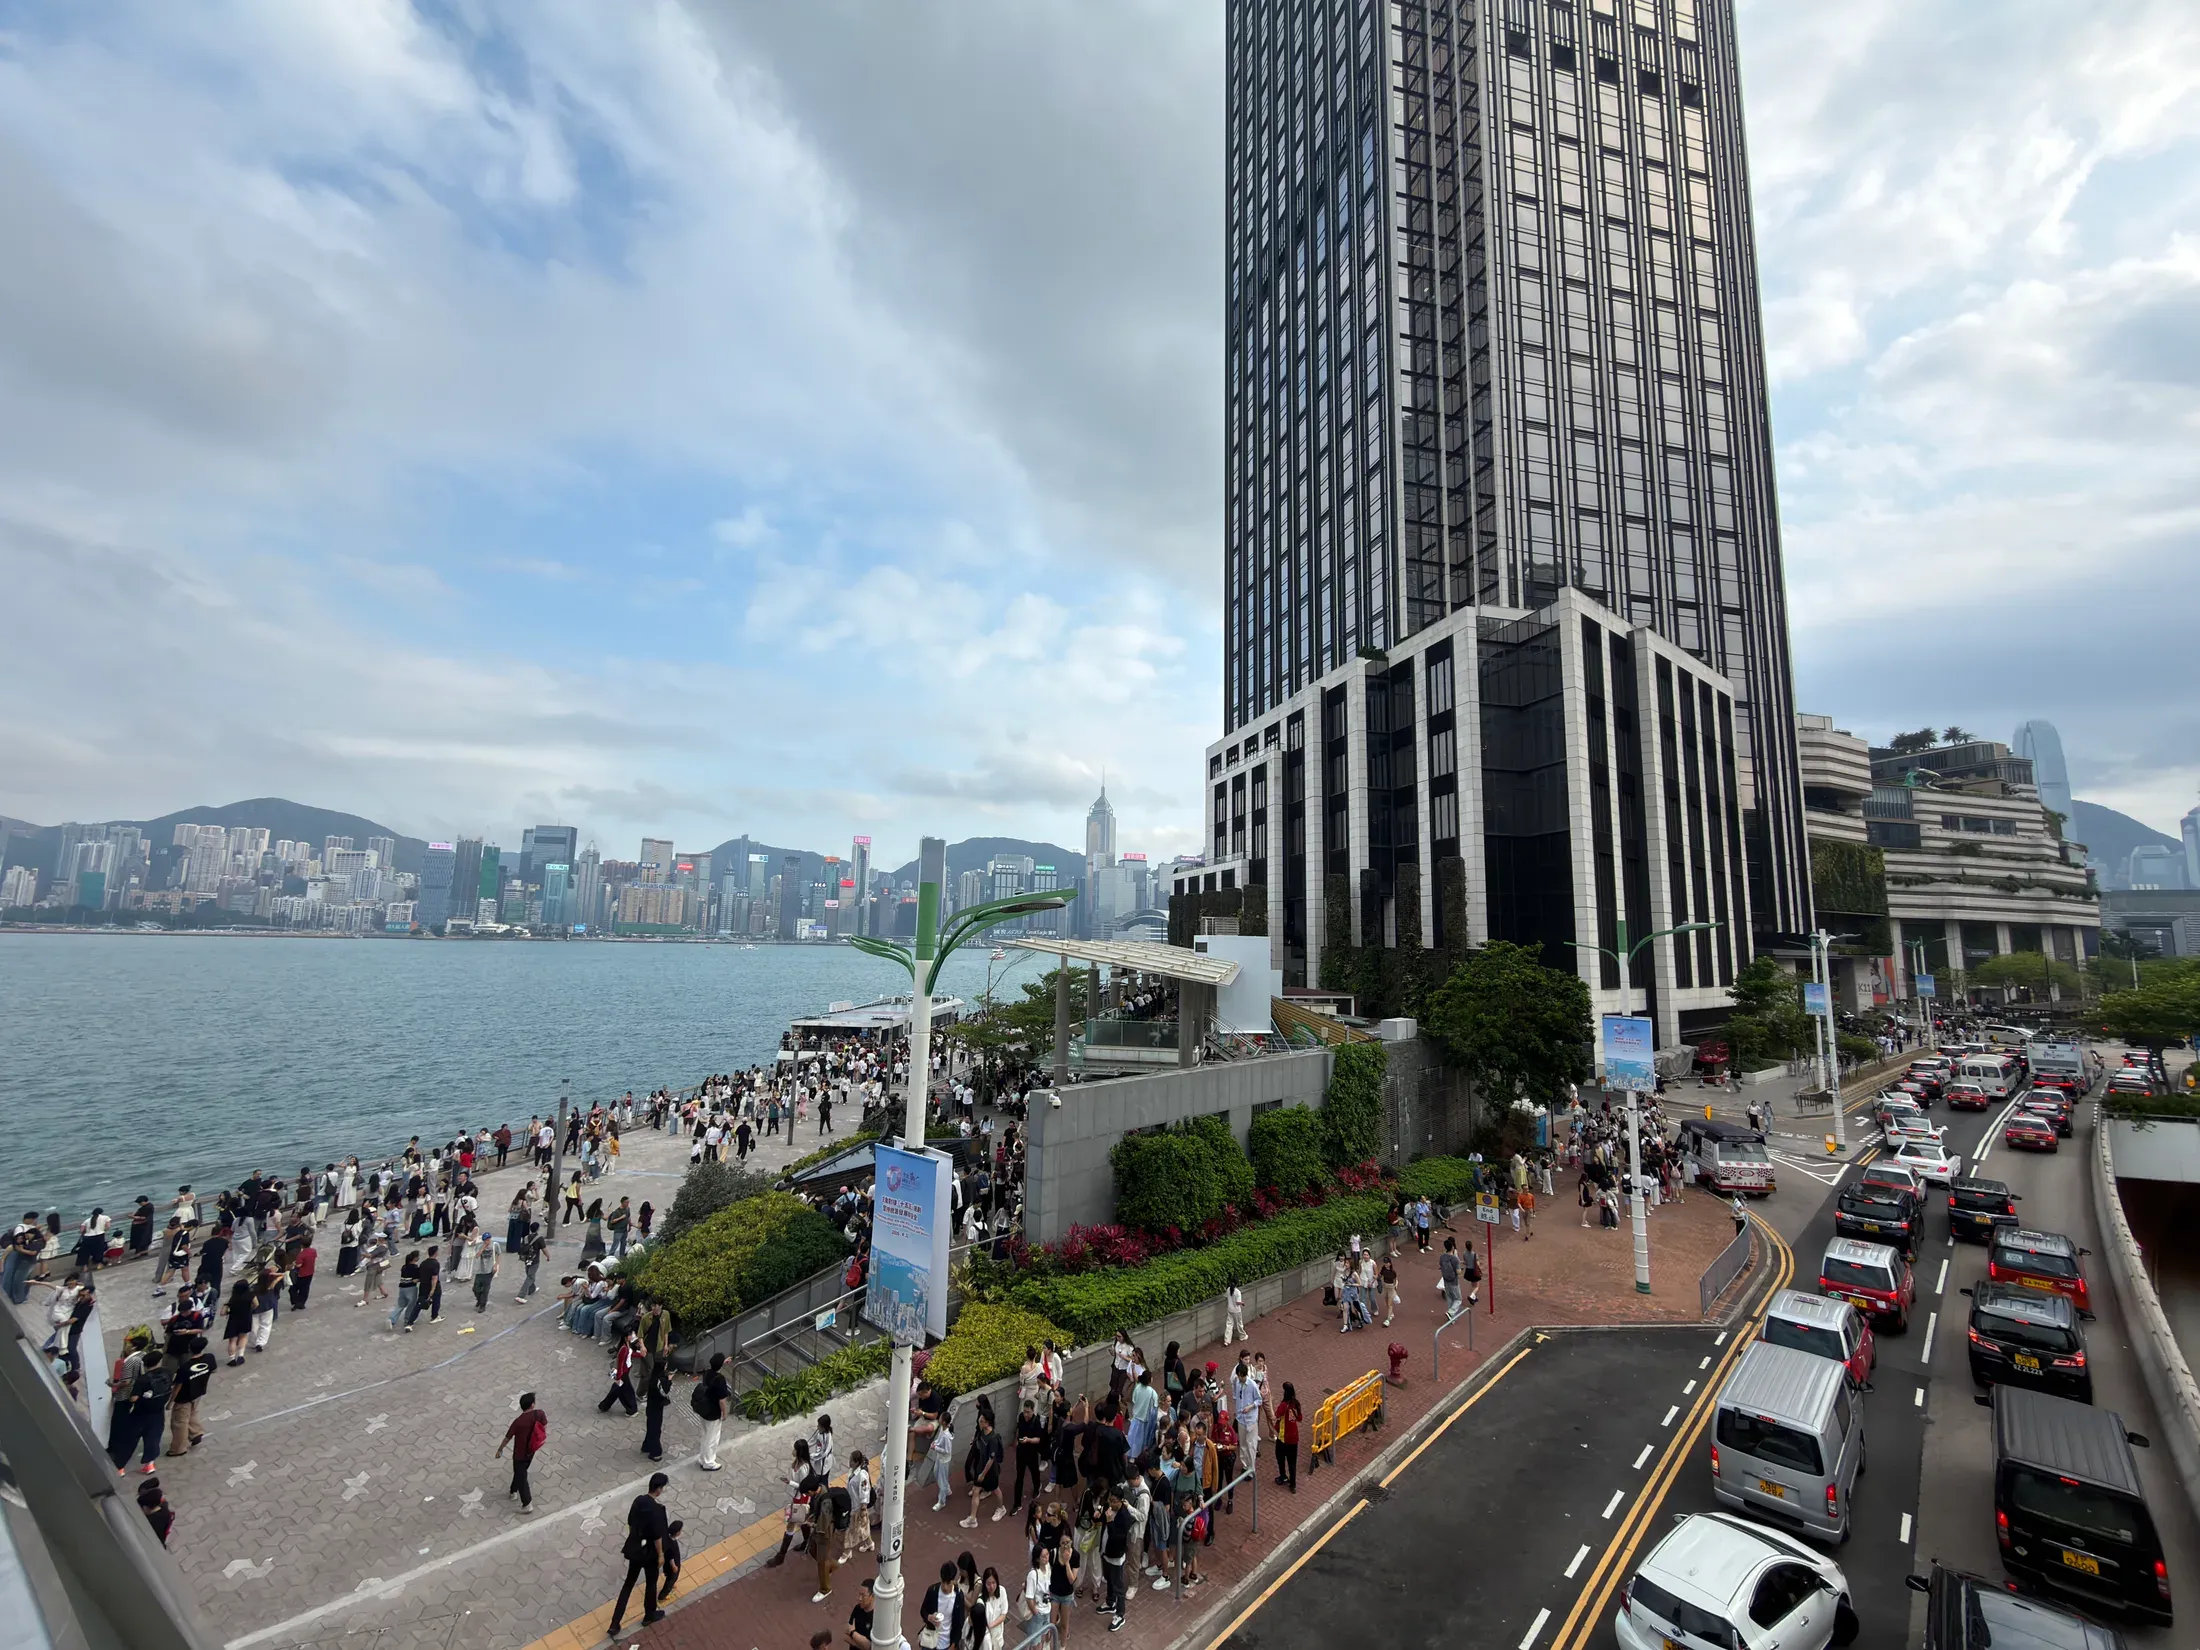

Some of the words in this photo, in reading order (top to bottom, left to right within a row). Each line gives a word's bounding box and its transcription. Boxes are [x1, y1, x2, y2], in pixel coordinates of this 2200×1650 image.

[631, 881, 677, 890] Panasonic
[1858, 983, 1871, 992] K11
[1482, 1206, 1494, 1214] End
